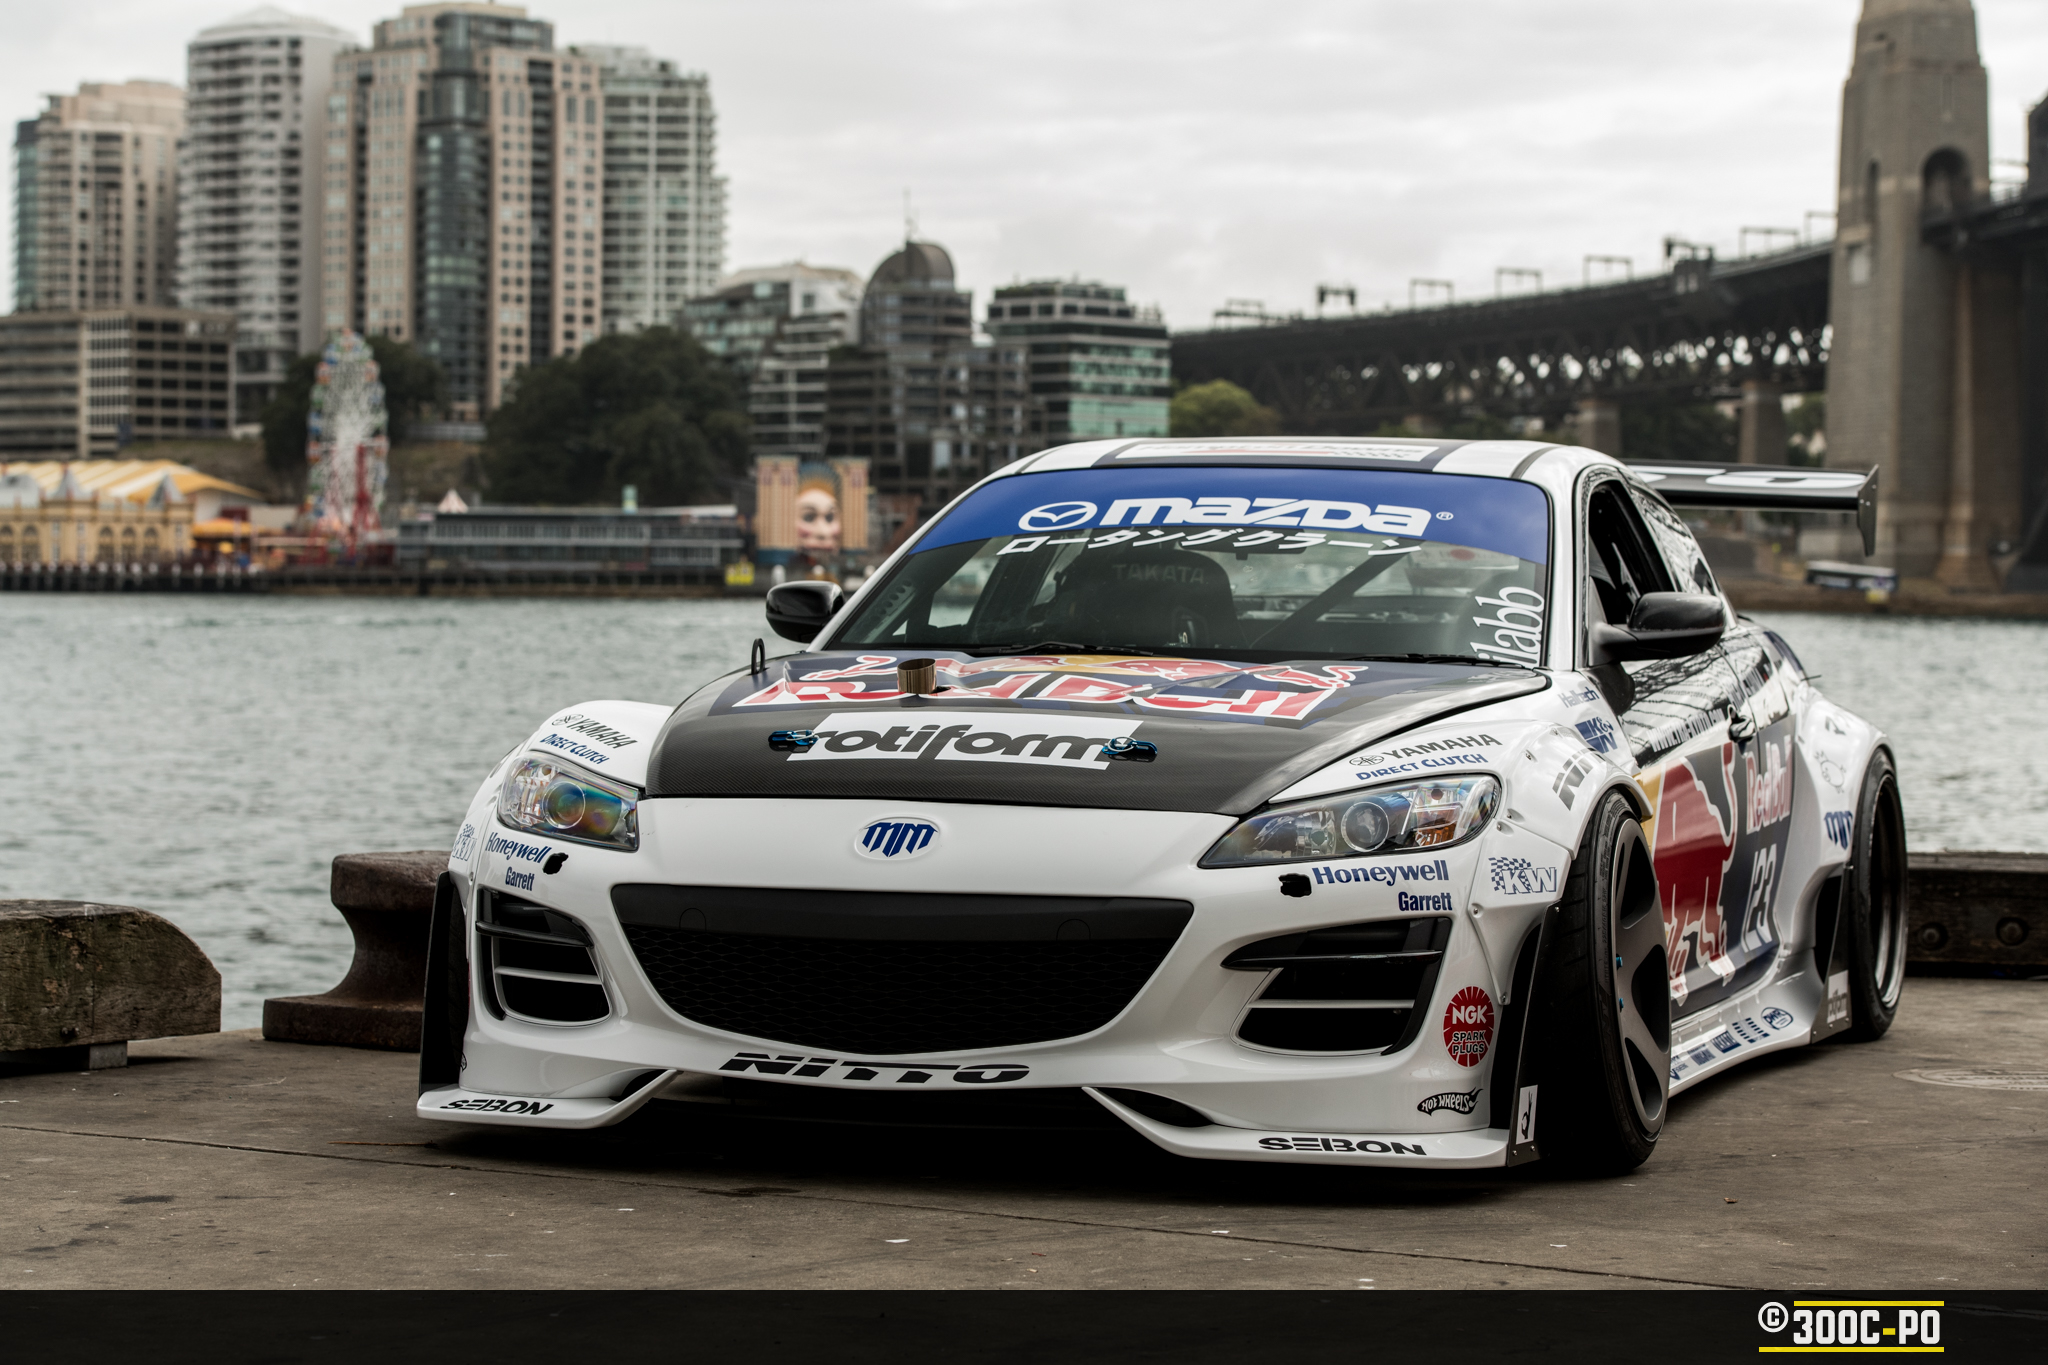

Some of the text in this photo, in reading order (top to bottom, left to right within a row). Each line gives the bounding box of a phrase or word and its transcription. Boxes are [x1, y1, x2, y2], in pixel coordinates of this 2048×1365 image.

[1112, 563, 1204, 585] TAKATA
[567, 718, 638, 749] YAMAHA
[814, 724, 1112, 762] rotiform
[540, 733, 610, 765] DIRECT CLUTCH
[1381, 734, 1503, 760] YAMAHA
[1356, 753, 1488, 781] DIRECT CLUTCH
[485, 832, 552, 863] Honeywell
[505, 867, 535, 891] Garrett
[1312, 860, 1449, 886] Honeywell
[1501, 867, 1558, 895] KW
[1398, 891, 1453, 911] Garrett
[1452, 1005, 1488, 1025] NGK
[1452, 1043, 1485, 1055] PLUGS
[1453, 1031, 1485, 1042] SPARK
[718, 1052, 1030, 1084] NITTO
[439, 1099, 555, 1116] SEBON
[1258, 1137, 1428, 1156] SEBON
